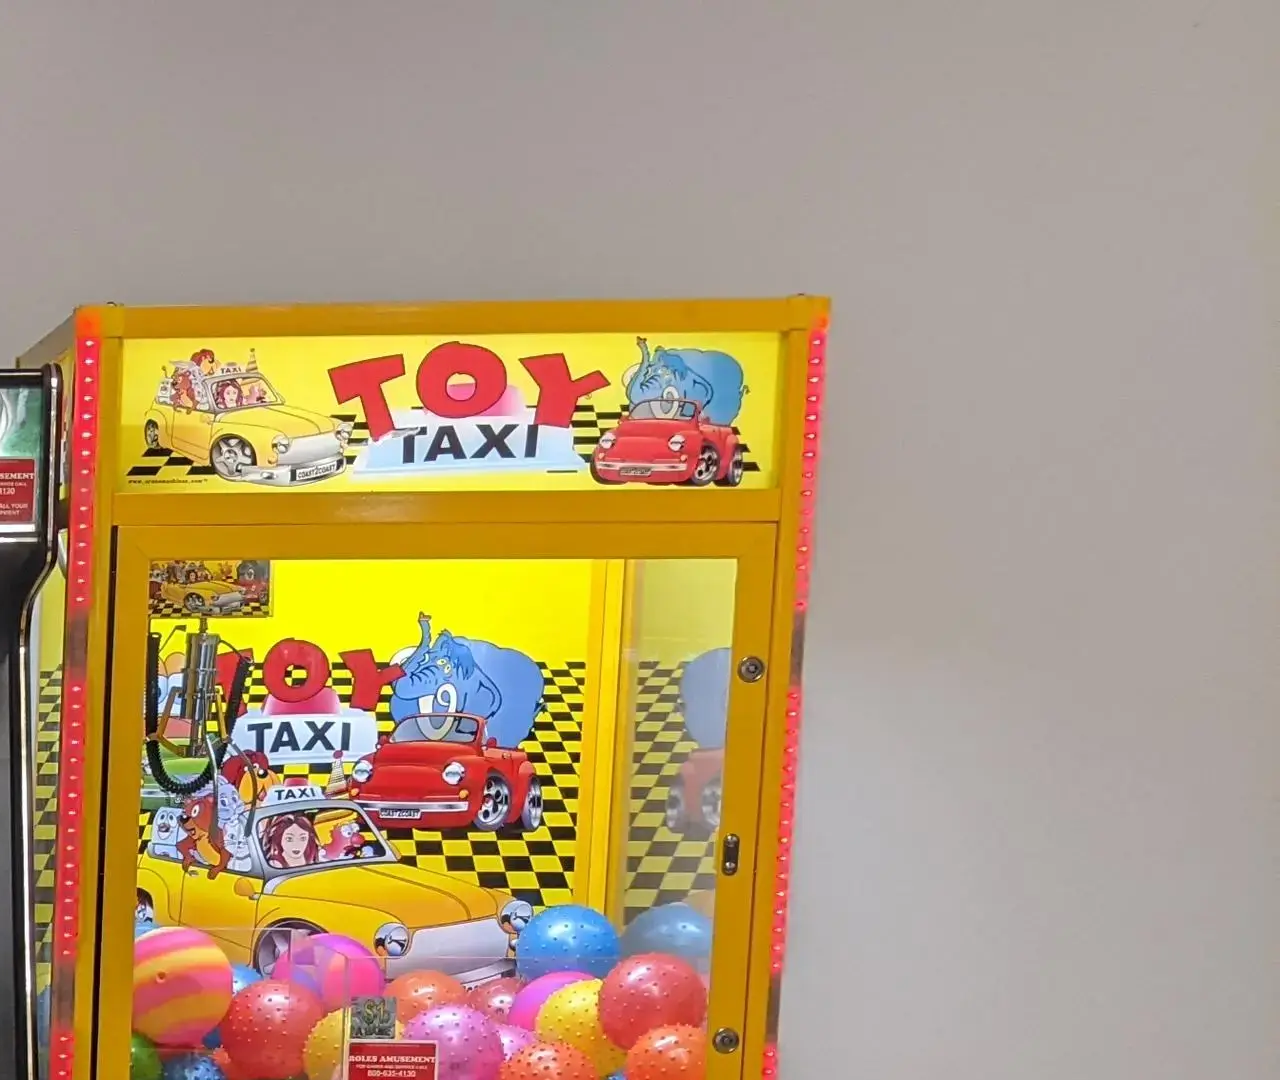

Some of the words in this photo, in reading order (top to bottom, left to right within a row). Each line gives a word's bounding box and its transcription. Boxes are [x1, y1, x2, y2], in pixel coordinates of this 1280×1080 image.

[327, 341, 610, 442] TOY
[400, 422, 540, 464] TAXI
[247, 720, 351, 754] TAXI
[274, 787, 316, 801] TAXI
[379, 1055, 436, 1063] AMUSEMENT
